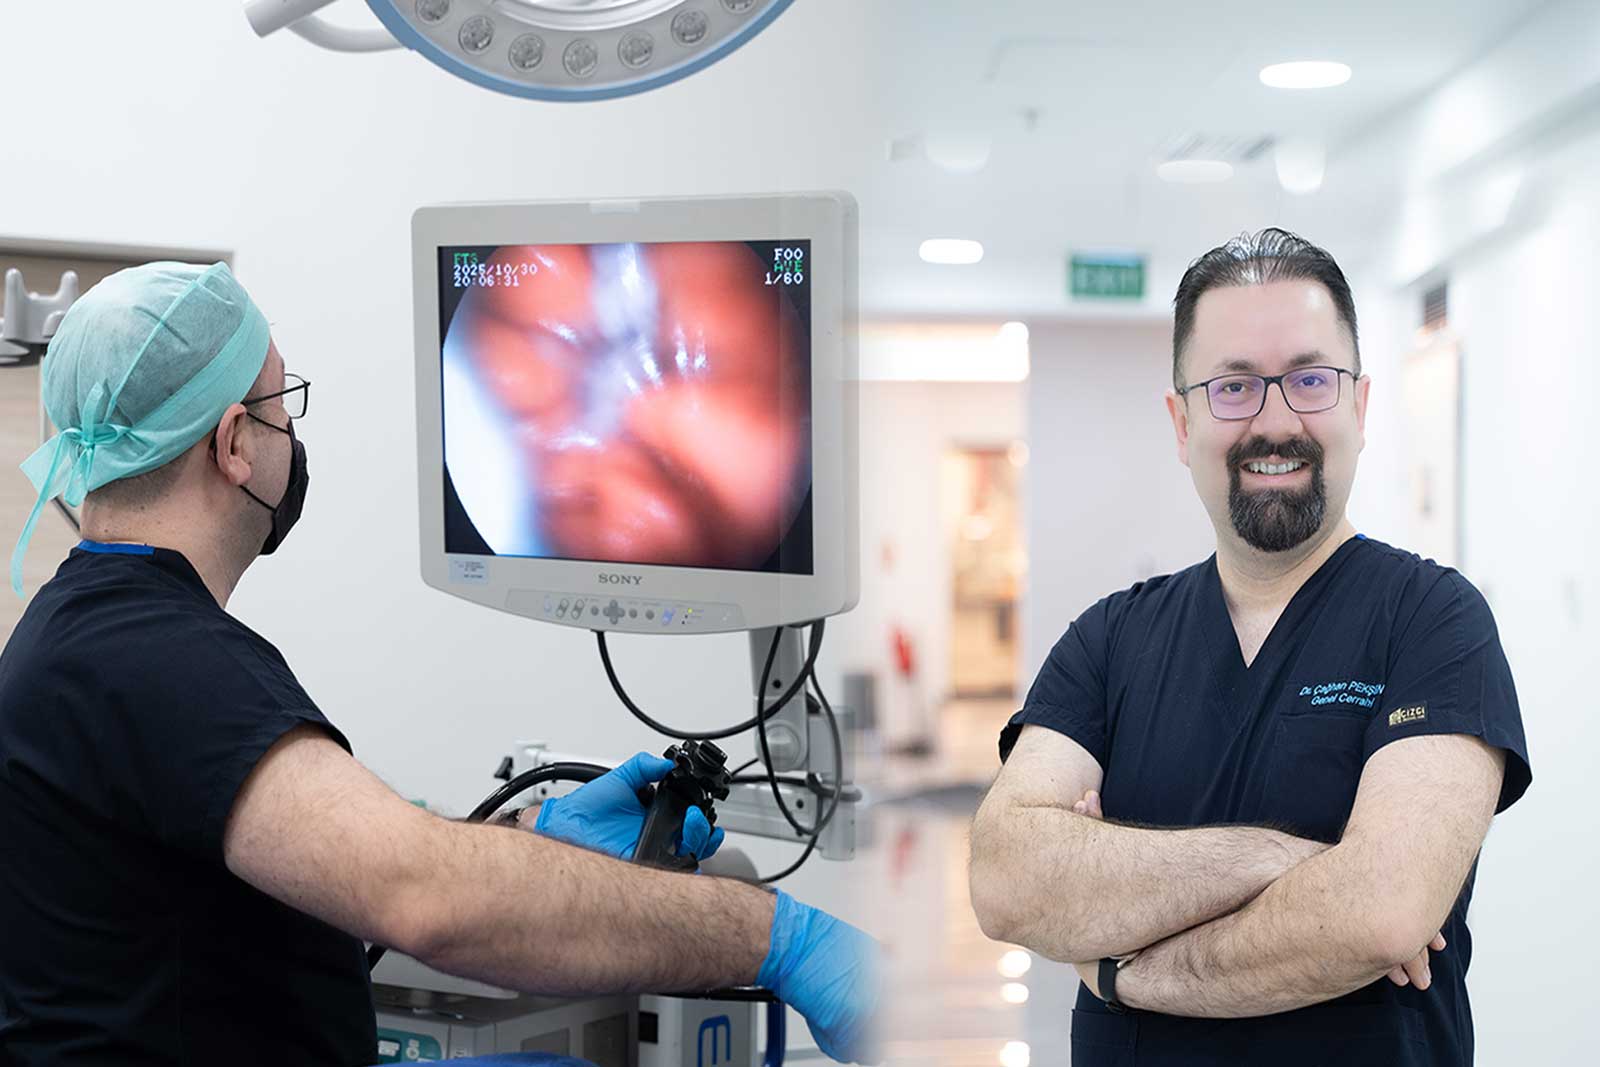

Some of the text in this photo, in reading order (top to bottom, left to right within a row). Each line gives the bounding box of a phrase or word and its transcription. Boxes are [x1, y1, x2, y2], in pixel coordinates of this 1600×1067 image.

[453, 264, 538, 276] 2025/10/30
[453, 275, 519, 287] 20:06:31
[765, 272, 803, 285] 1/60
[598, 574, 643, 585] SONY
[1311, 694, 1338, 705] Genel
